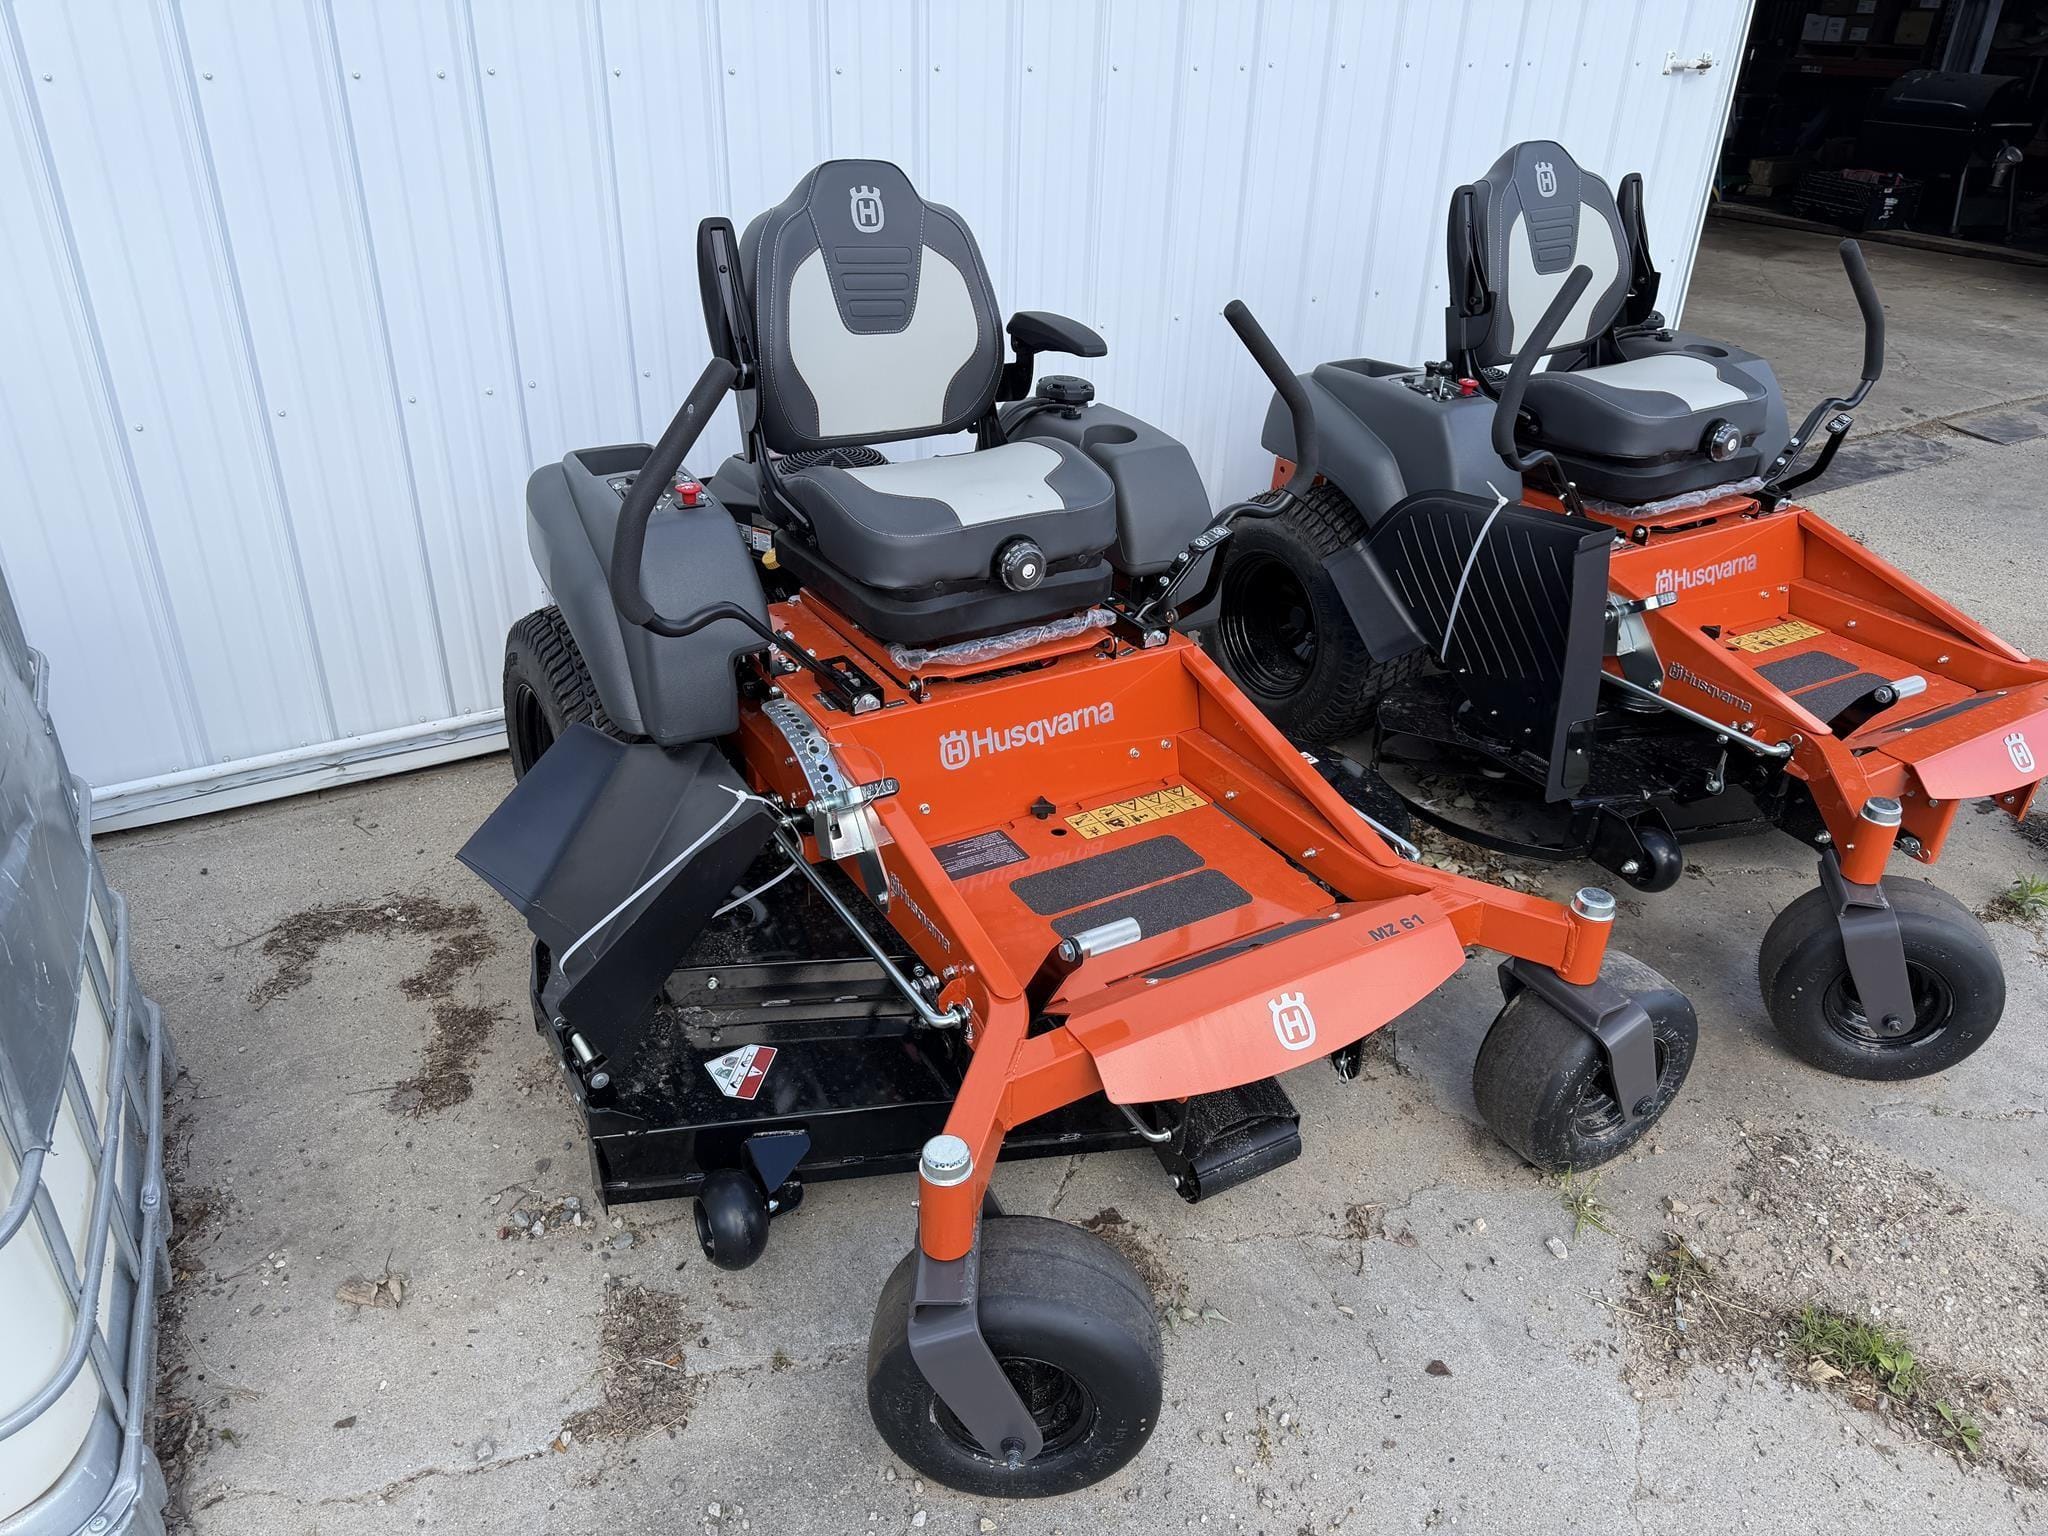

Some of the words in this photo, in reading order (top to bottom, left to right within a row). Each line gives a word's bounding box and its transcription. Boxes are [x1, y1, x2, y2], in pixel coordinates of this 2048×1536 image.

[1674, 553, 1757, 592] Husqvarna
[1683, 668, 1753, 714] Husqvarna
[971, 701, 1115, 758] Husqvarna
[1367, 922, 1401, 942] MZ
[1400, 913, 1425, 930] 61
